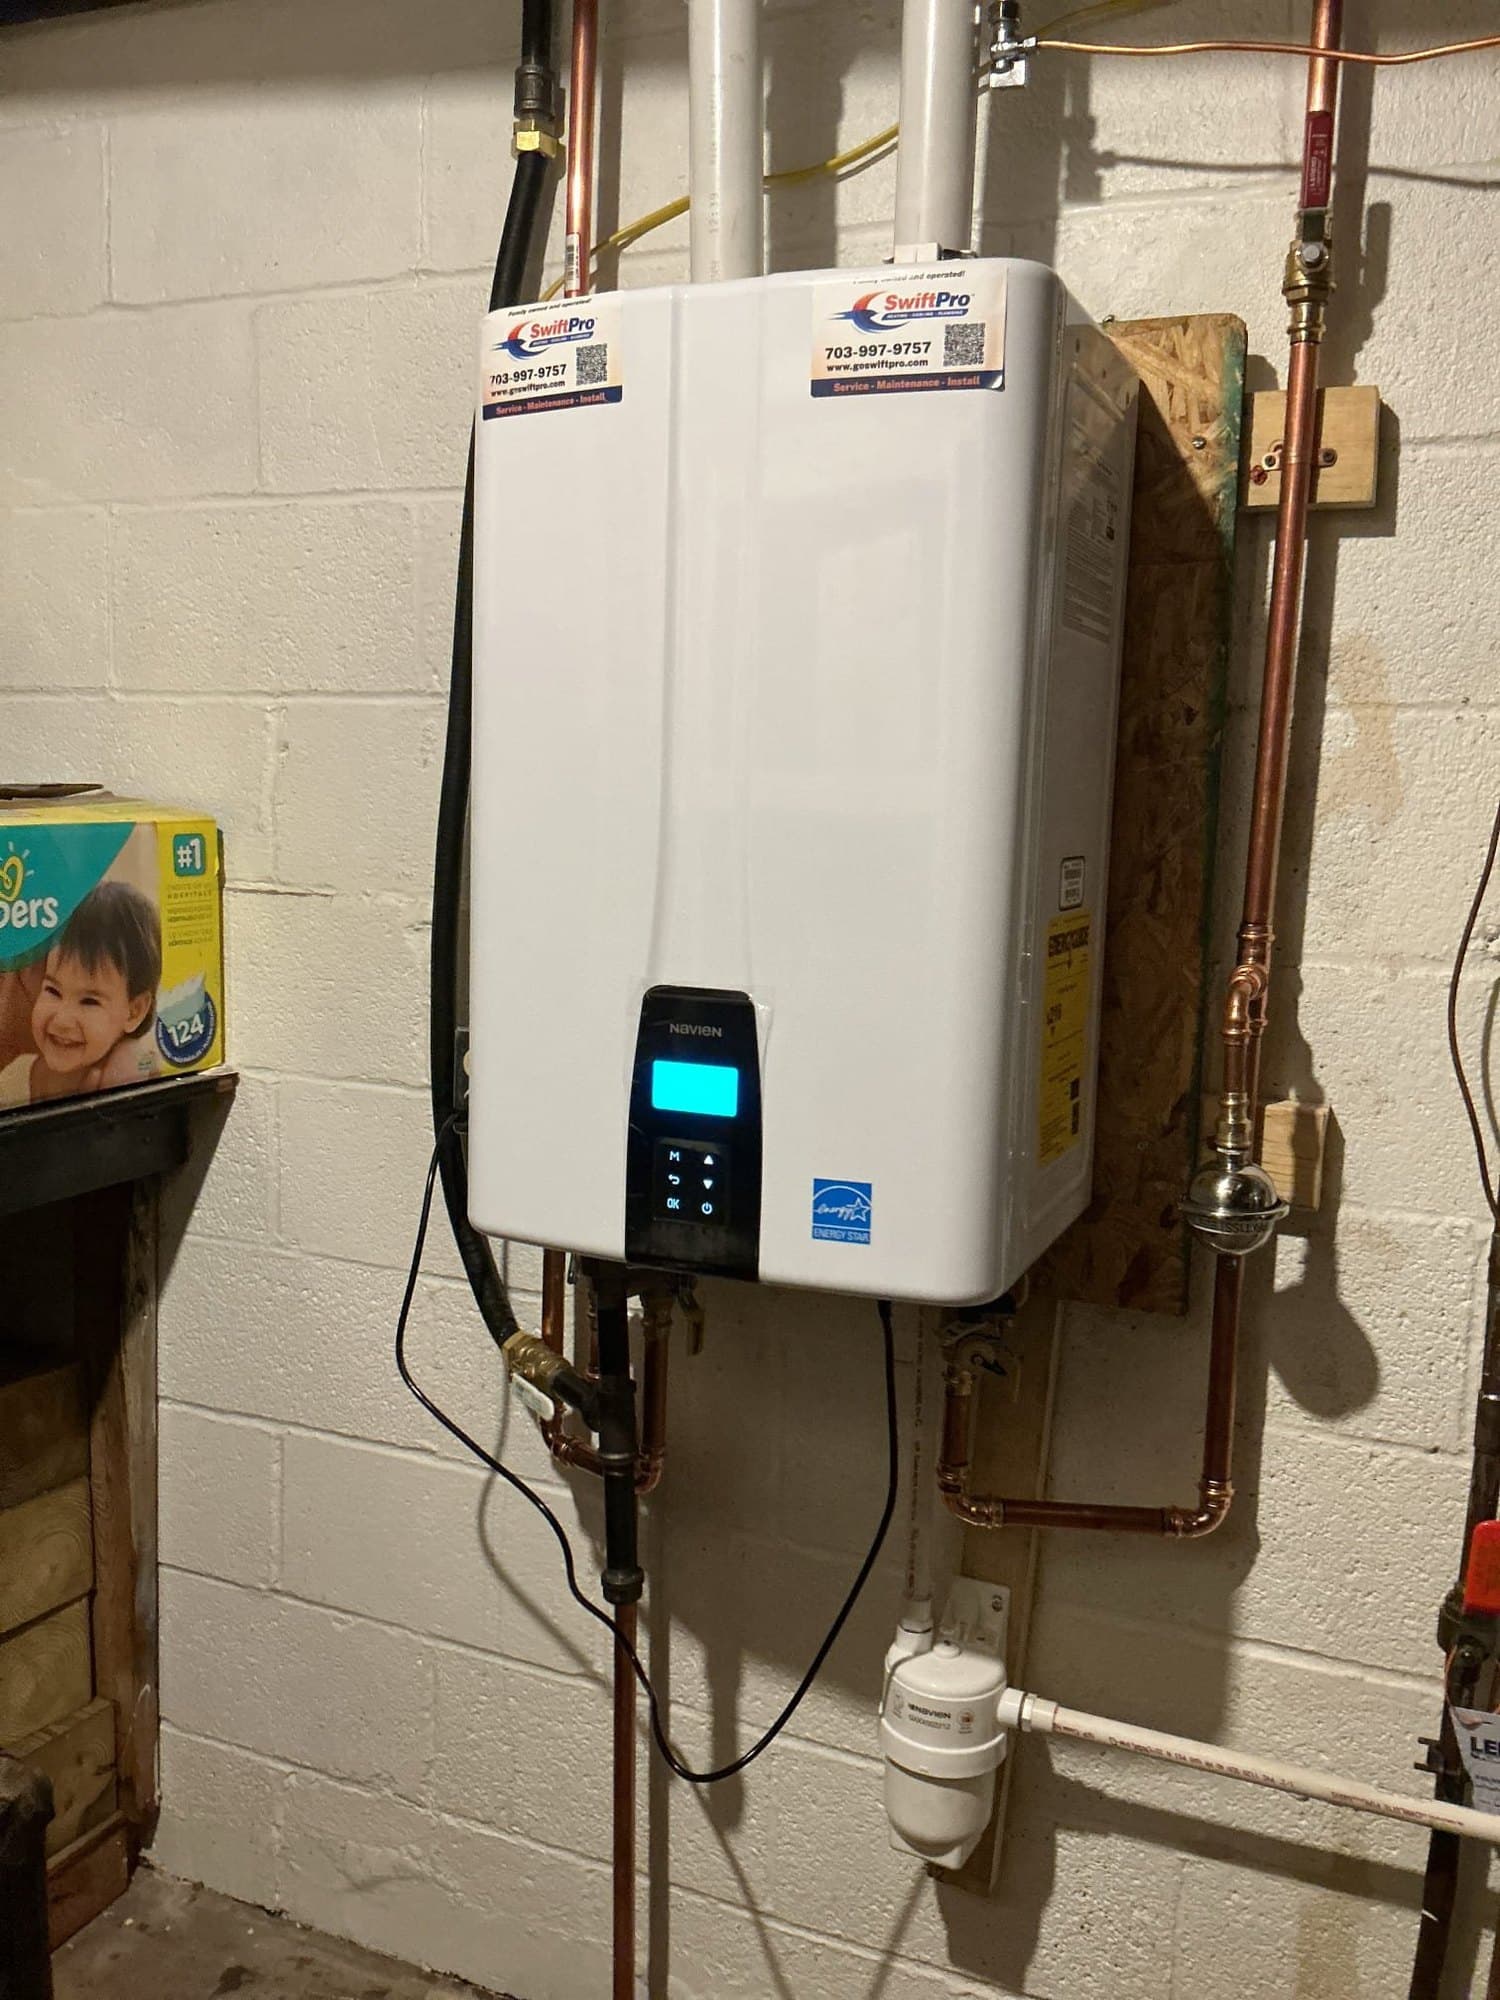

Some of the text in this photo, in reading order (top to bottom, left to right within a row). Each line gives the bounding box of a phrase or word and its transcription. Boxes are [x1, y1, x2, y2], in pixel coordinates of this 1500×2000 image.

[885, 292, 971, 310] SwiftPro
[530, 317, 595, 339] SwiftPro
[825, 341, 931, 360] 703-997-9757
[490, 364, 567, 385] 703-997-9757
[827, 359, 929, 373] www.goswiftpro.com
[833, 381, 869, 393] Service
[876, 378, 940, 391] Maintenance
[947, 375, 981, 387] Install
[496, 405, 523, 416] Service
[527, 398, 575, 410] Maintenance
[580, 392, 606, 404] Install
[177, 838, 201, 870] #1
[168, 1013, 204, 1046] 124
[669, 1150, 681, 1162] M
[666, 1197, 680, 1210] OK
[814, 1228, 847, 1240] ENERGY
